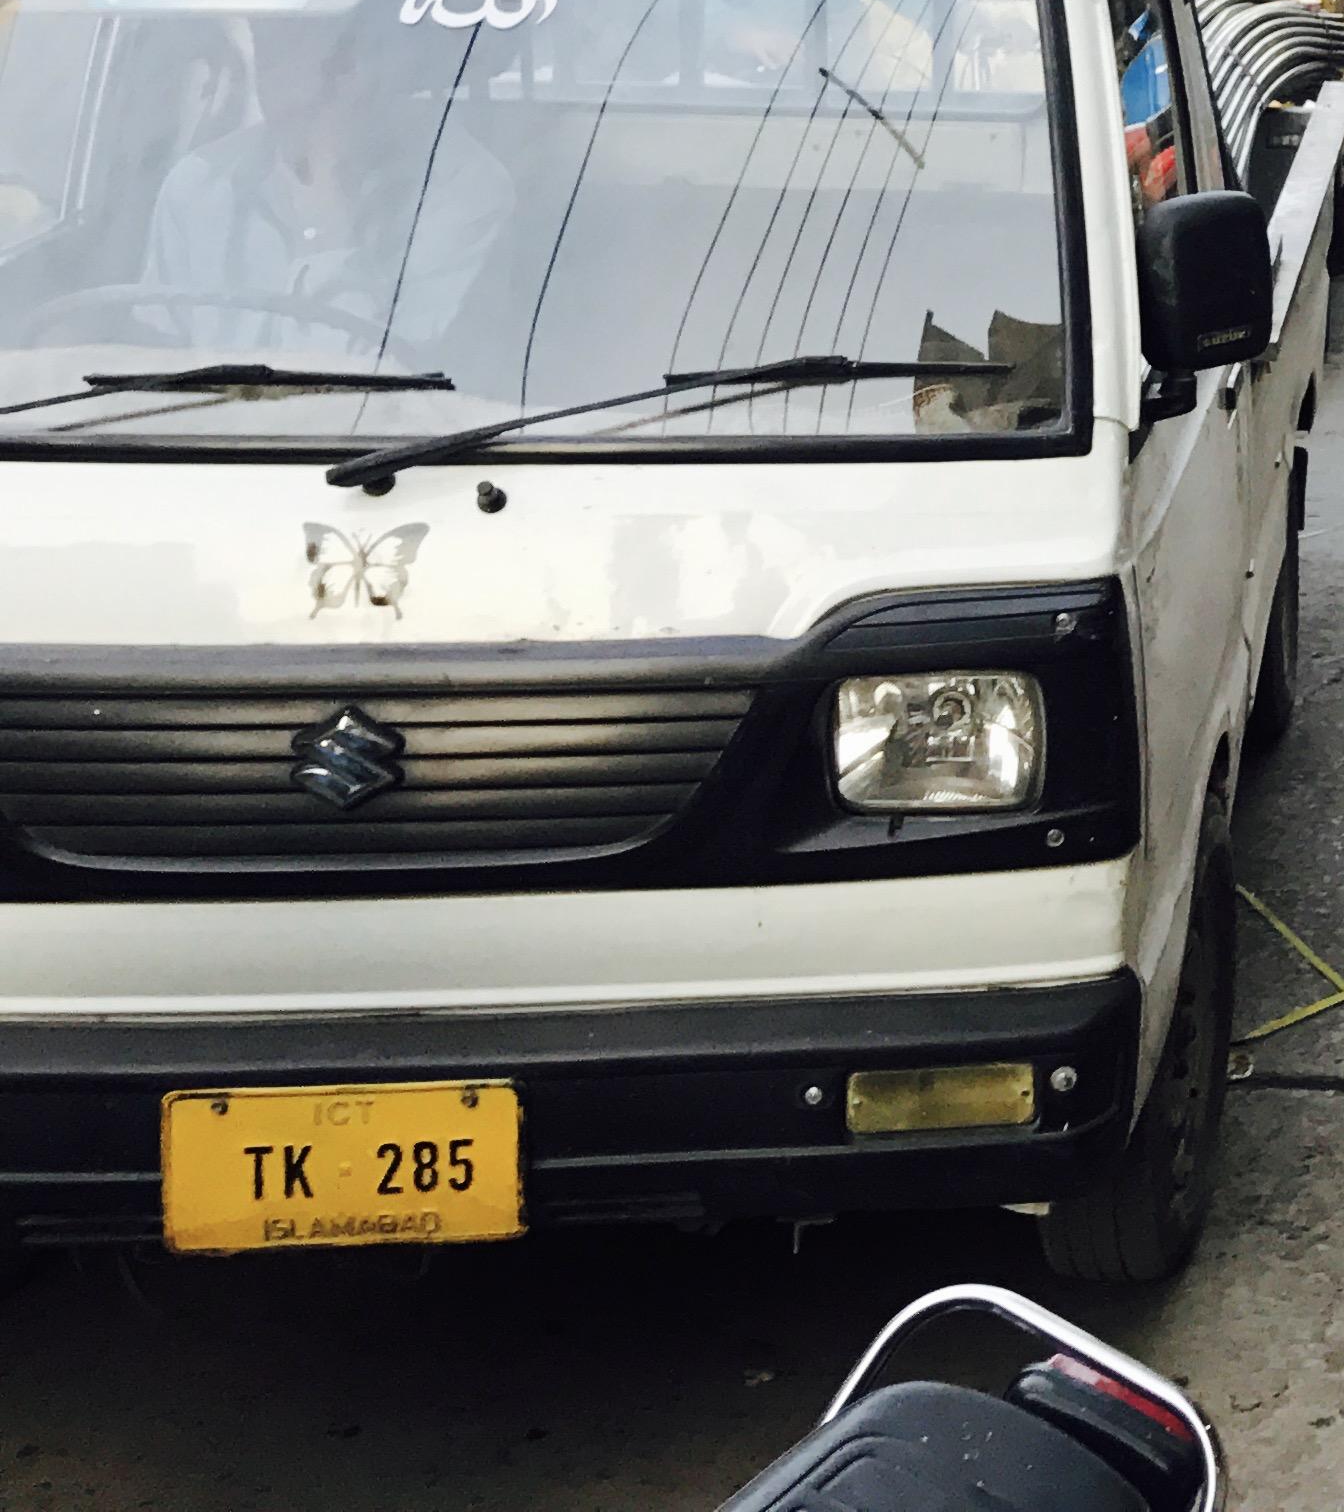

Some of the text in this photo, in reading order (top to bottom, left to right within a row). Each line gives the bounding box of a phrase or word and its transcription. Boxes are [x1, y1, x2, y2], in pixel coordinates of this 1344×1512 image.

[313, 1100, 375, 1127] ICT
[243, 1138, 474, 1200] TK 285
[263, 1211, 443, 1241] ISLAMABAD
